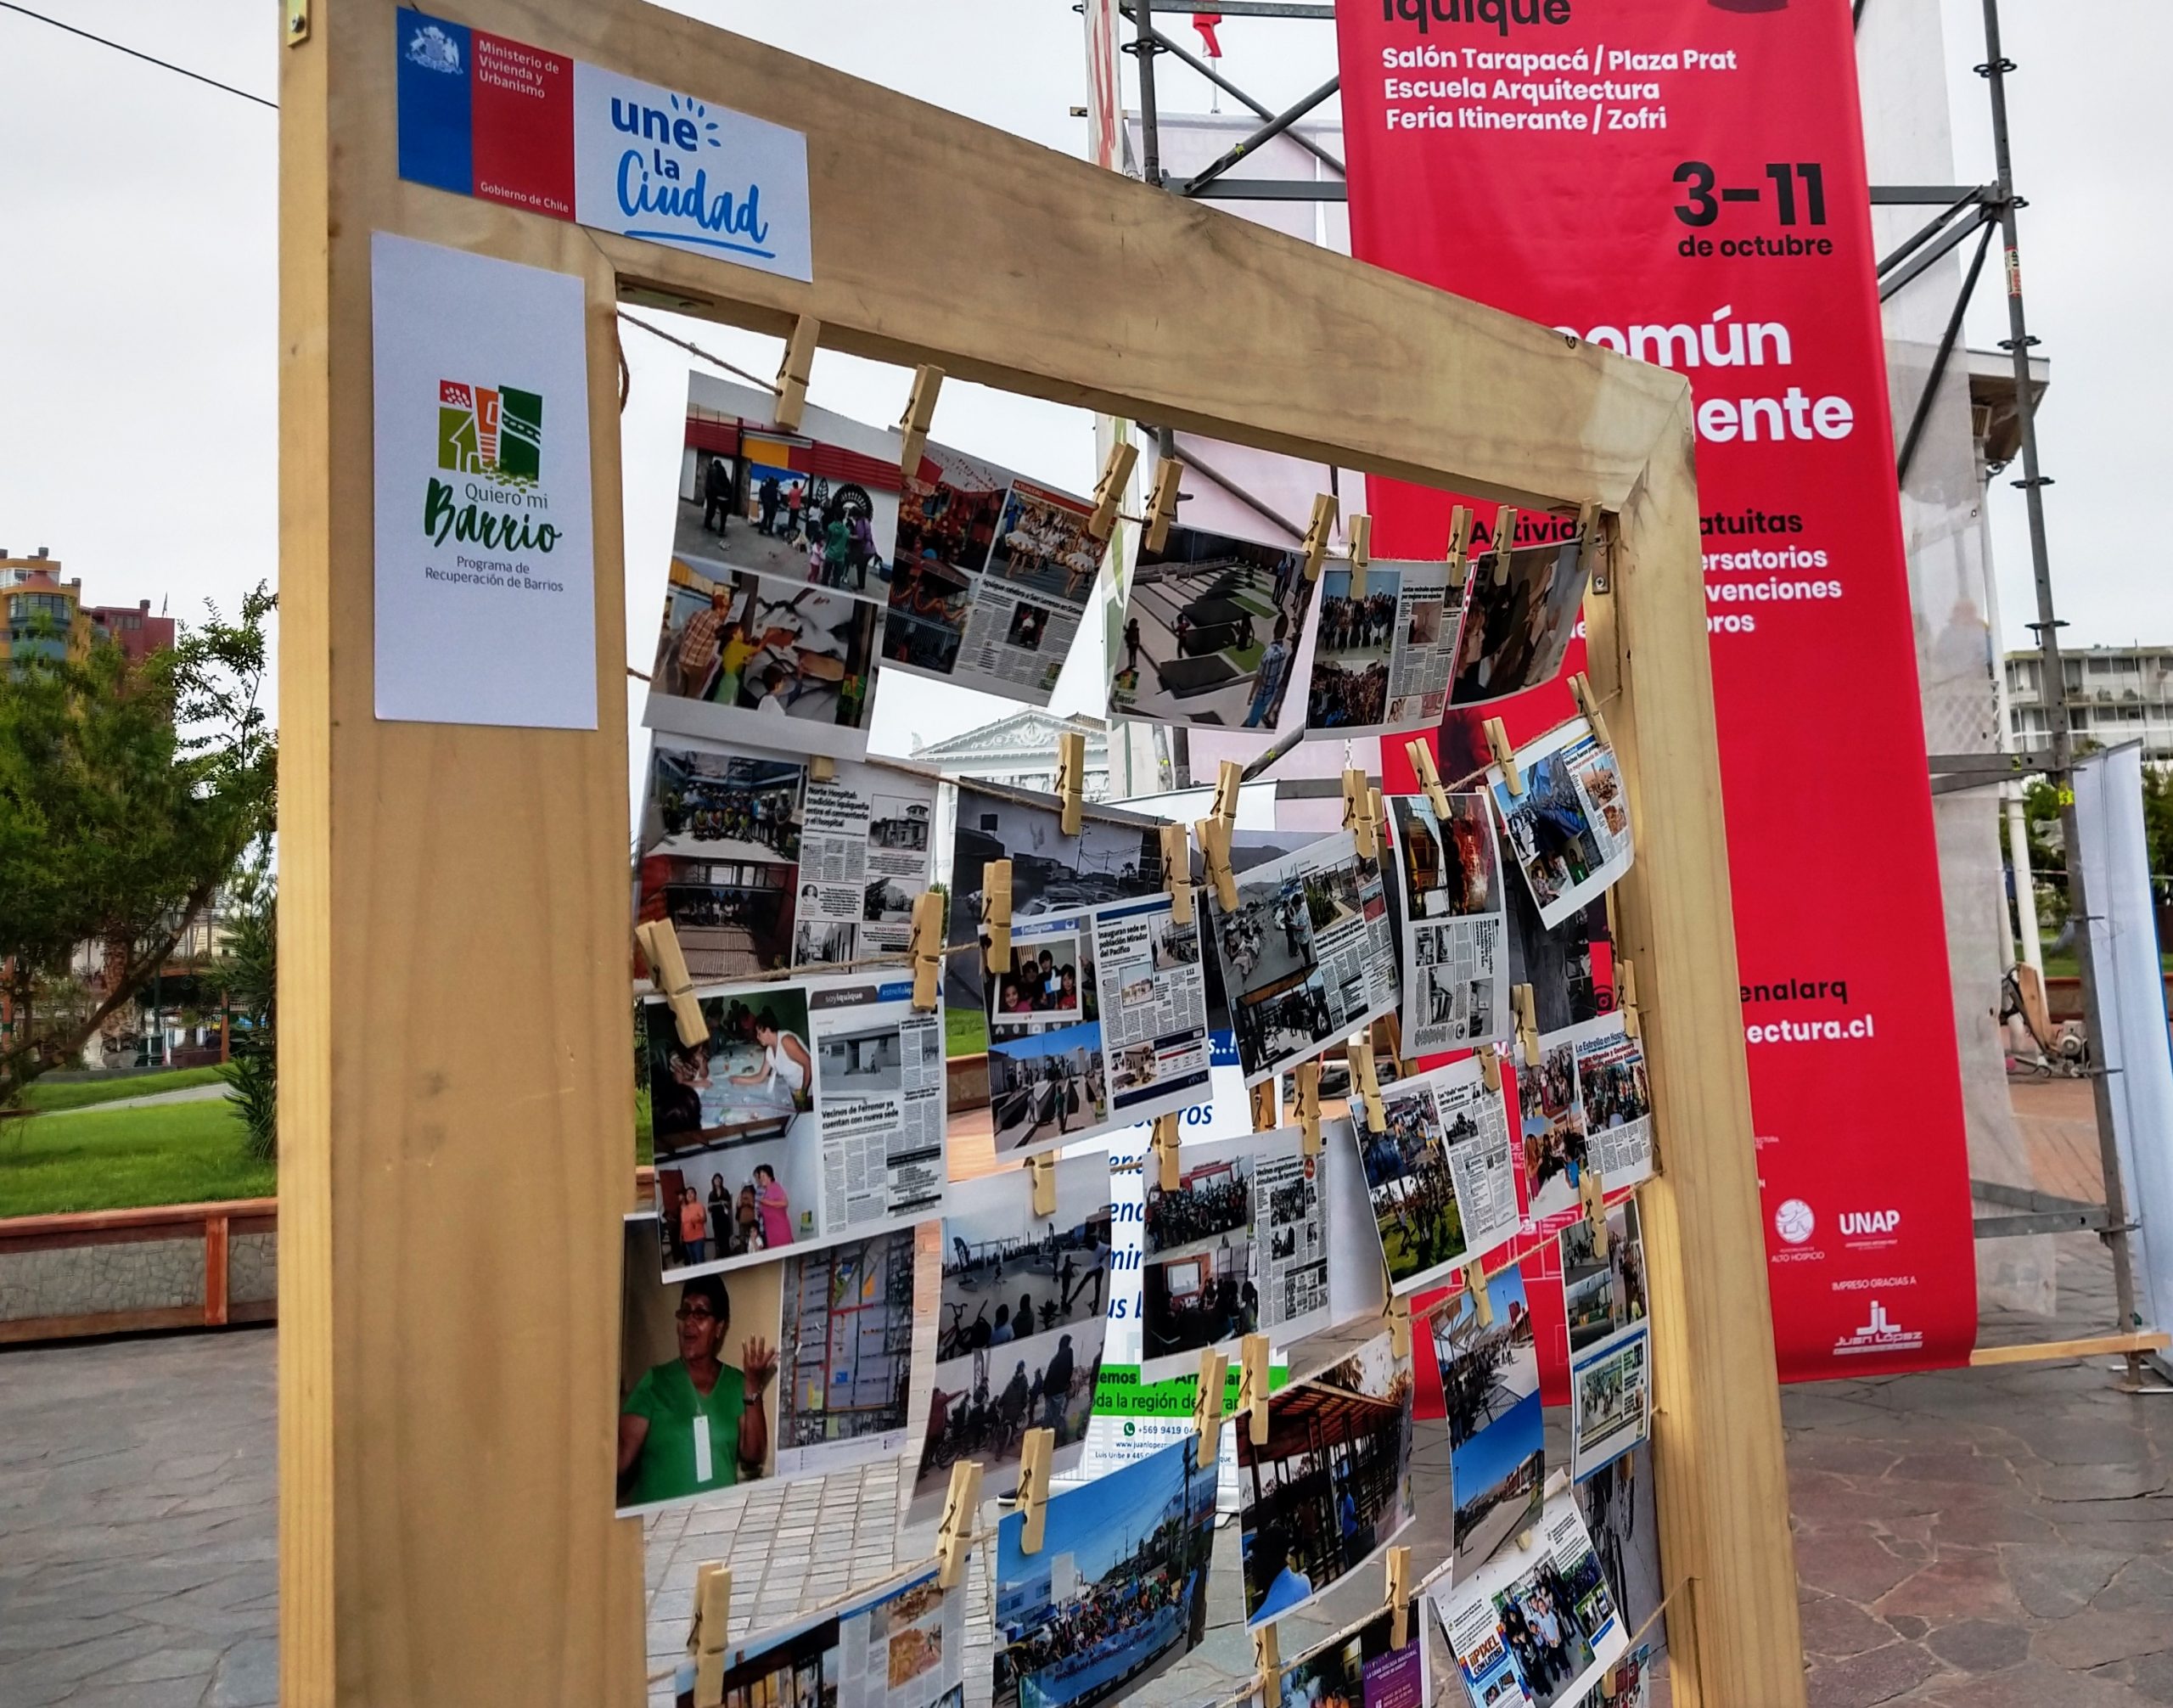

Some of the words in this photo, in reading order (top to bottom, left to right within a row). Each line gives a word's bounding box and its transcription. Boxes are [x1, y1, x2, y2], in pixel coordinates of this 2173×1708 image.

[479, 40, 542, 70] Ministerio
[545, 59, 559, 75] de
[479, 54, 533, 82] Vivienda
[536, 73, 543, 86] y
[1382, 47, 1457, 69] Salón
[1462, 48, 1589, 76] Tarapacá
[1608, 49, 1678, 71] Plaza
[1684, 49, 1737, 70] Prat
[479, 70, 545, 99] Urbanismo
[1384, 78, 1486, 100] Escuela
[1492, 78, 1659, 107] Arquitectura
[611, 97, 699, 152] une
[1385, 108, 1453, 131] Feria
[1457, 108, 1587, 131] Itinerante
[1607, 105, 1667, 130] Zofri
[654, 149, 680, 181] la
[480, 181, 527, 204] Gobierno
[529, 192, 542, 206] de
[543, 197, 569, 214] Chile
[616, 149, 768, 244] Ciudad
[1677, 234, 1713, 257] de
[1719, 234, 1833, 257] octubre
[1691, 387, 1854, 442] ente
[465, 482, 522, 506] Quiero
[526, 492, 548, 509] mi
[424, 477, 563, 553] Barrio
[1469, 515, 1578, 544] Ativid
[457, 555, 513, 575] Programa
[515, 561, 530, 575] de
[425, 567, 504, 587] Recuperación
[507, 575, 521, 588] de
[524, 576, 564, 593] Barrios
[1745, 1014, 1874, 1043] ectura.cl
[822, 1108, 847, 1120] Vecinos
[849, 1104, 857, 1115] de
[822, 1117, 850, 1130] cuentan
[851, 1115, 862, 1126] con
[863, 1112, 883, 1122] nueva
[884, 1109, 899, 1119] sede
[1839, 1210, 1901, 1235] UNAP
[1832, 1278, 1869, 1290] IMPRESO
[1870, 1276, 1909, 1288] GRACIAS
[1910, 1275, 1917, 1285] A
[1116, 1392, 1128, 1408] la
[1132, 1392, 1178, 1413] región
[1138, 1425, 1158, 1435] +569
[1160, 1425, 1182, 1435] 9419
